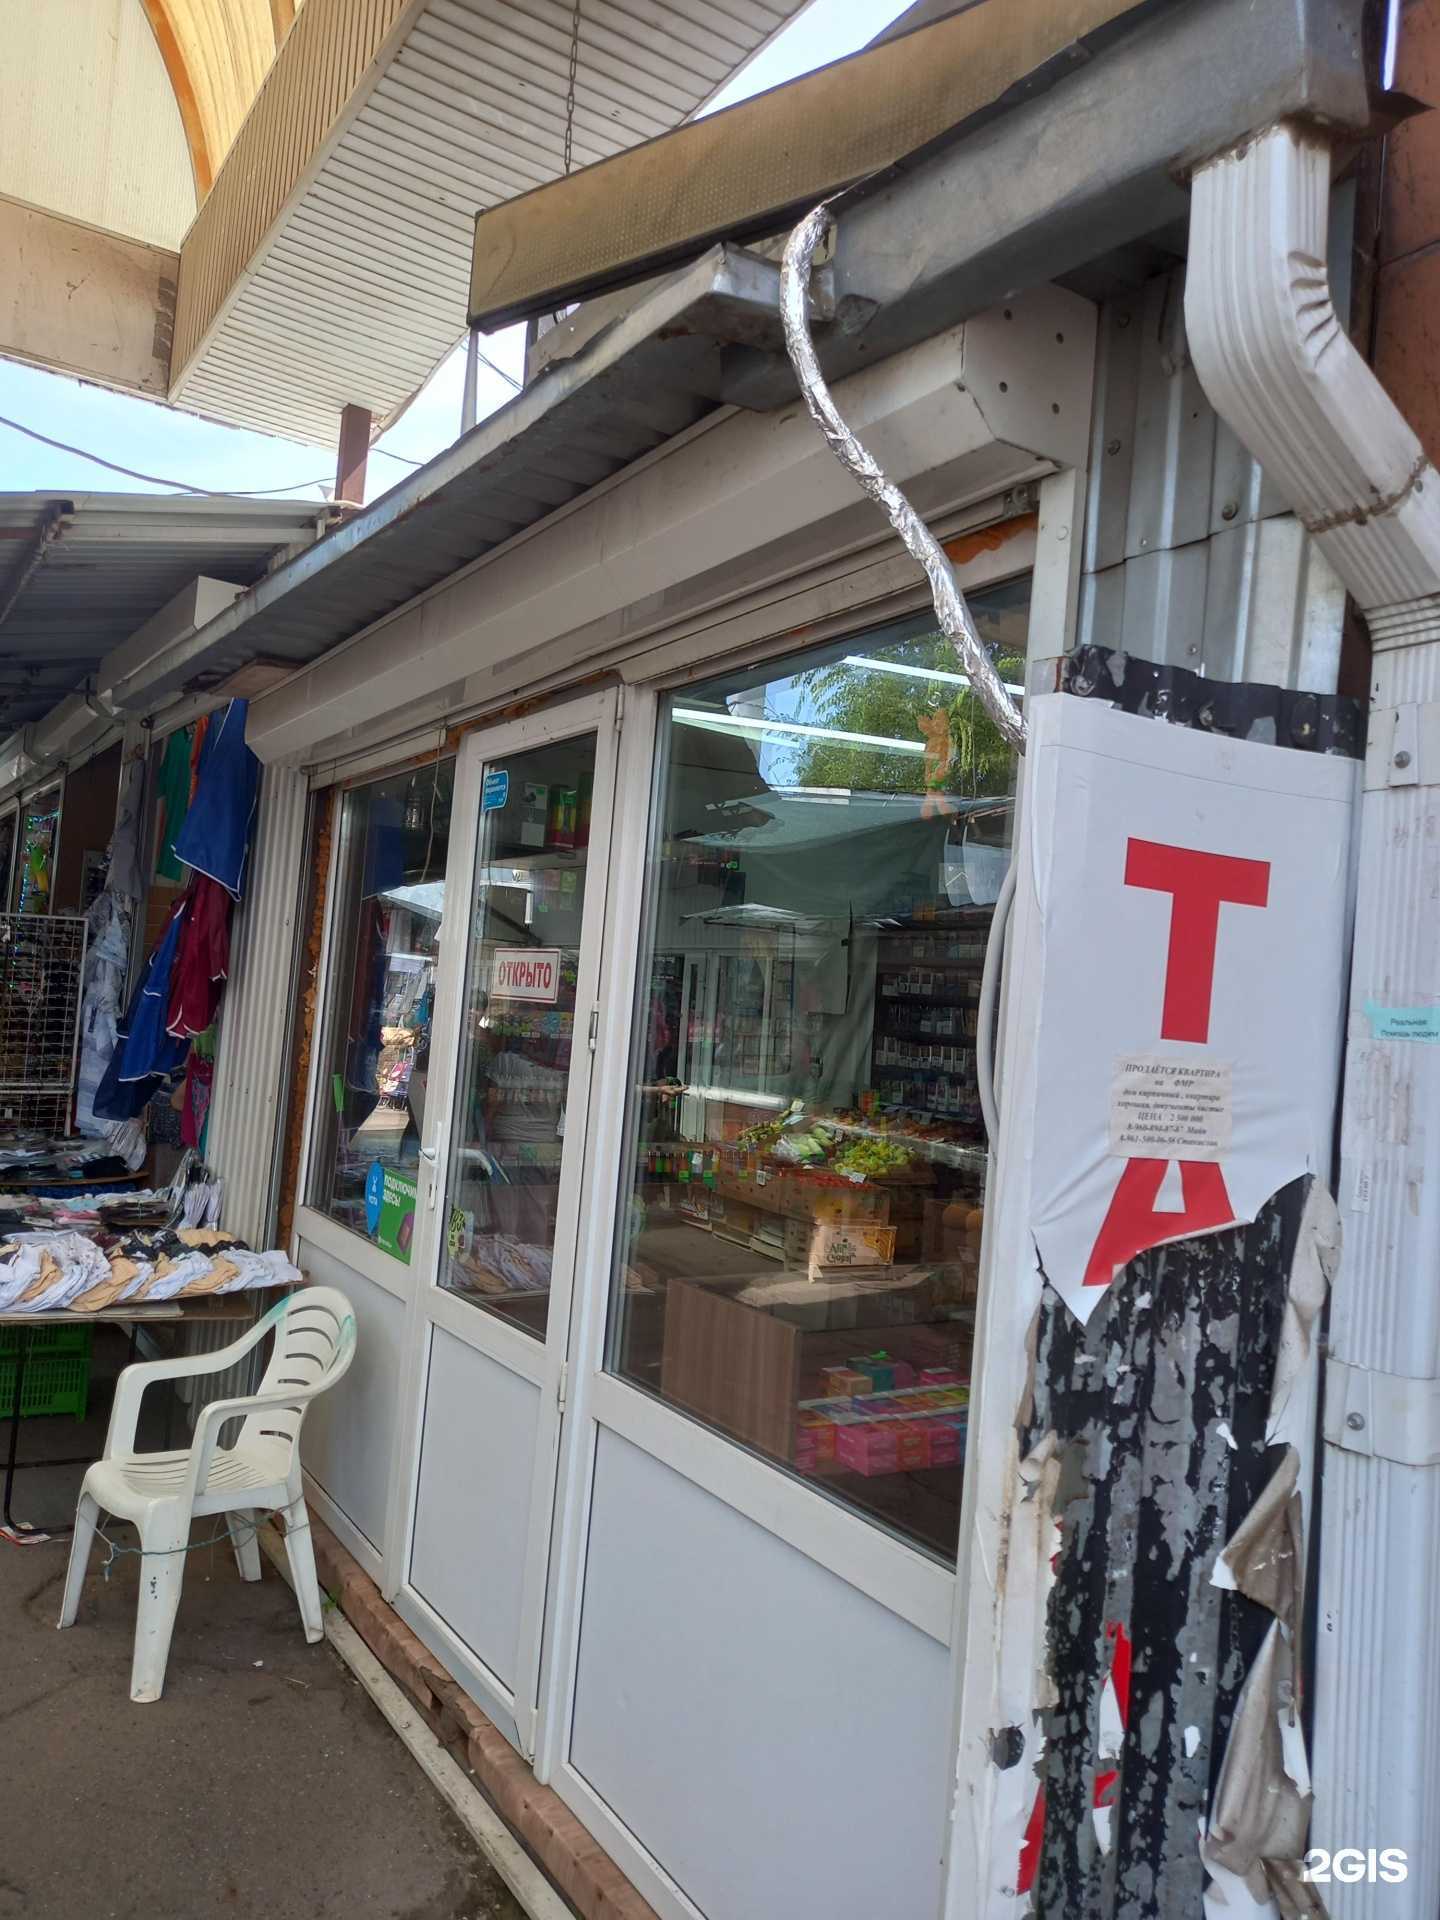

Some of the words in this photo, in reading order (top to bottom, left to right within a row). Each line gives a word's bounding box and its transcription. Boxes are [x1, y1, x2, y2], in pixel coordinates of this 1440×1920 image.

[498, 961, 552, 989] ОТКРЫТО
[1125, 1064, 1177, 1076] ПРОДАЁТСЯ
[1178, 1067, 1222, 1078] КВАРТИРА
